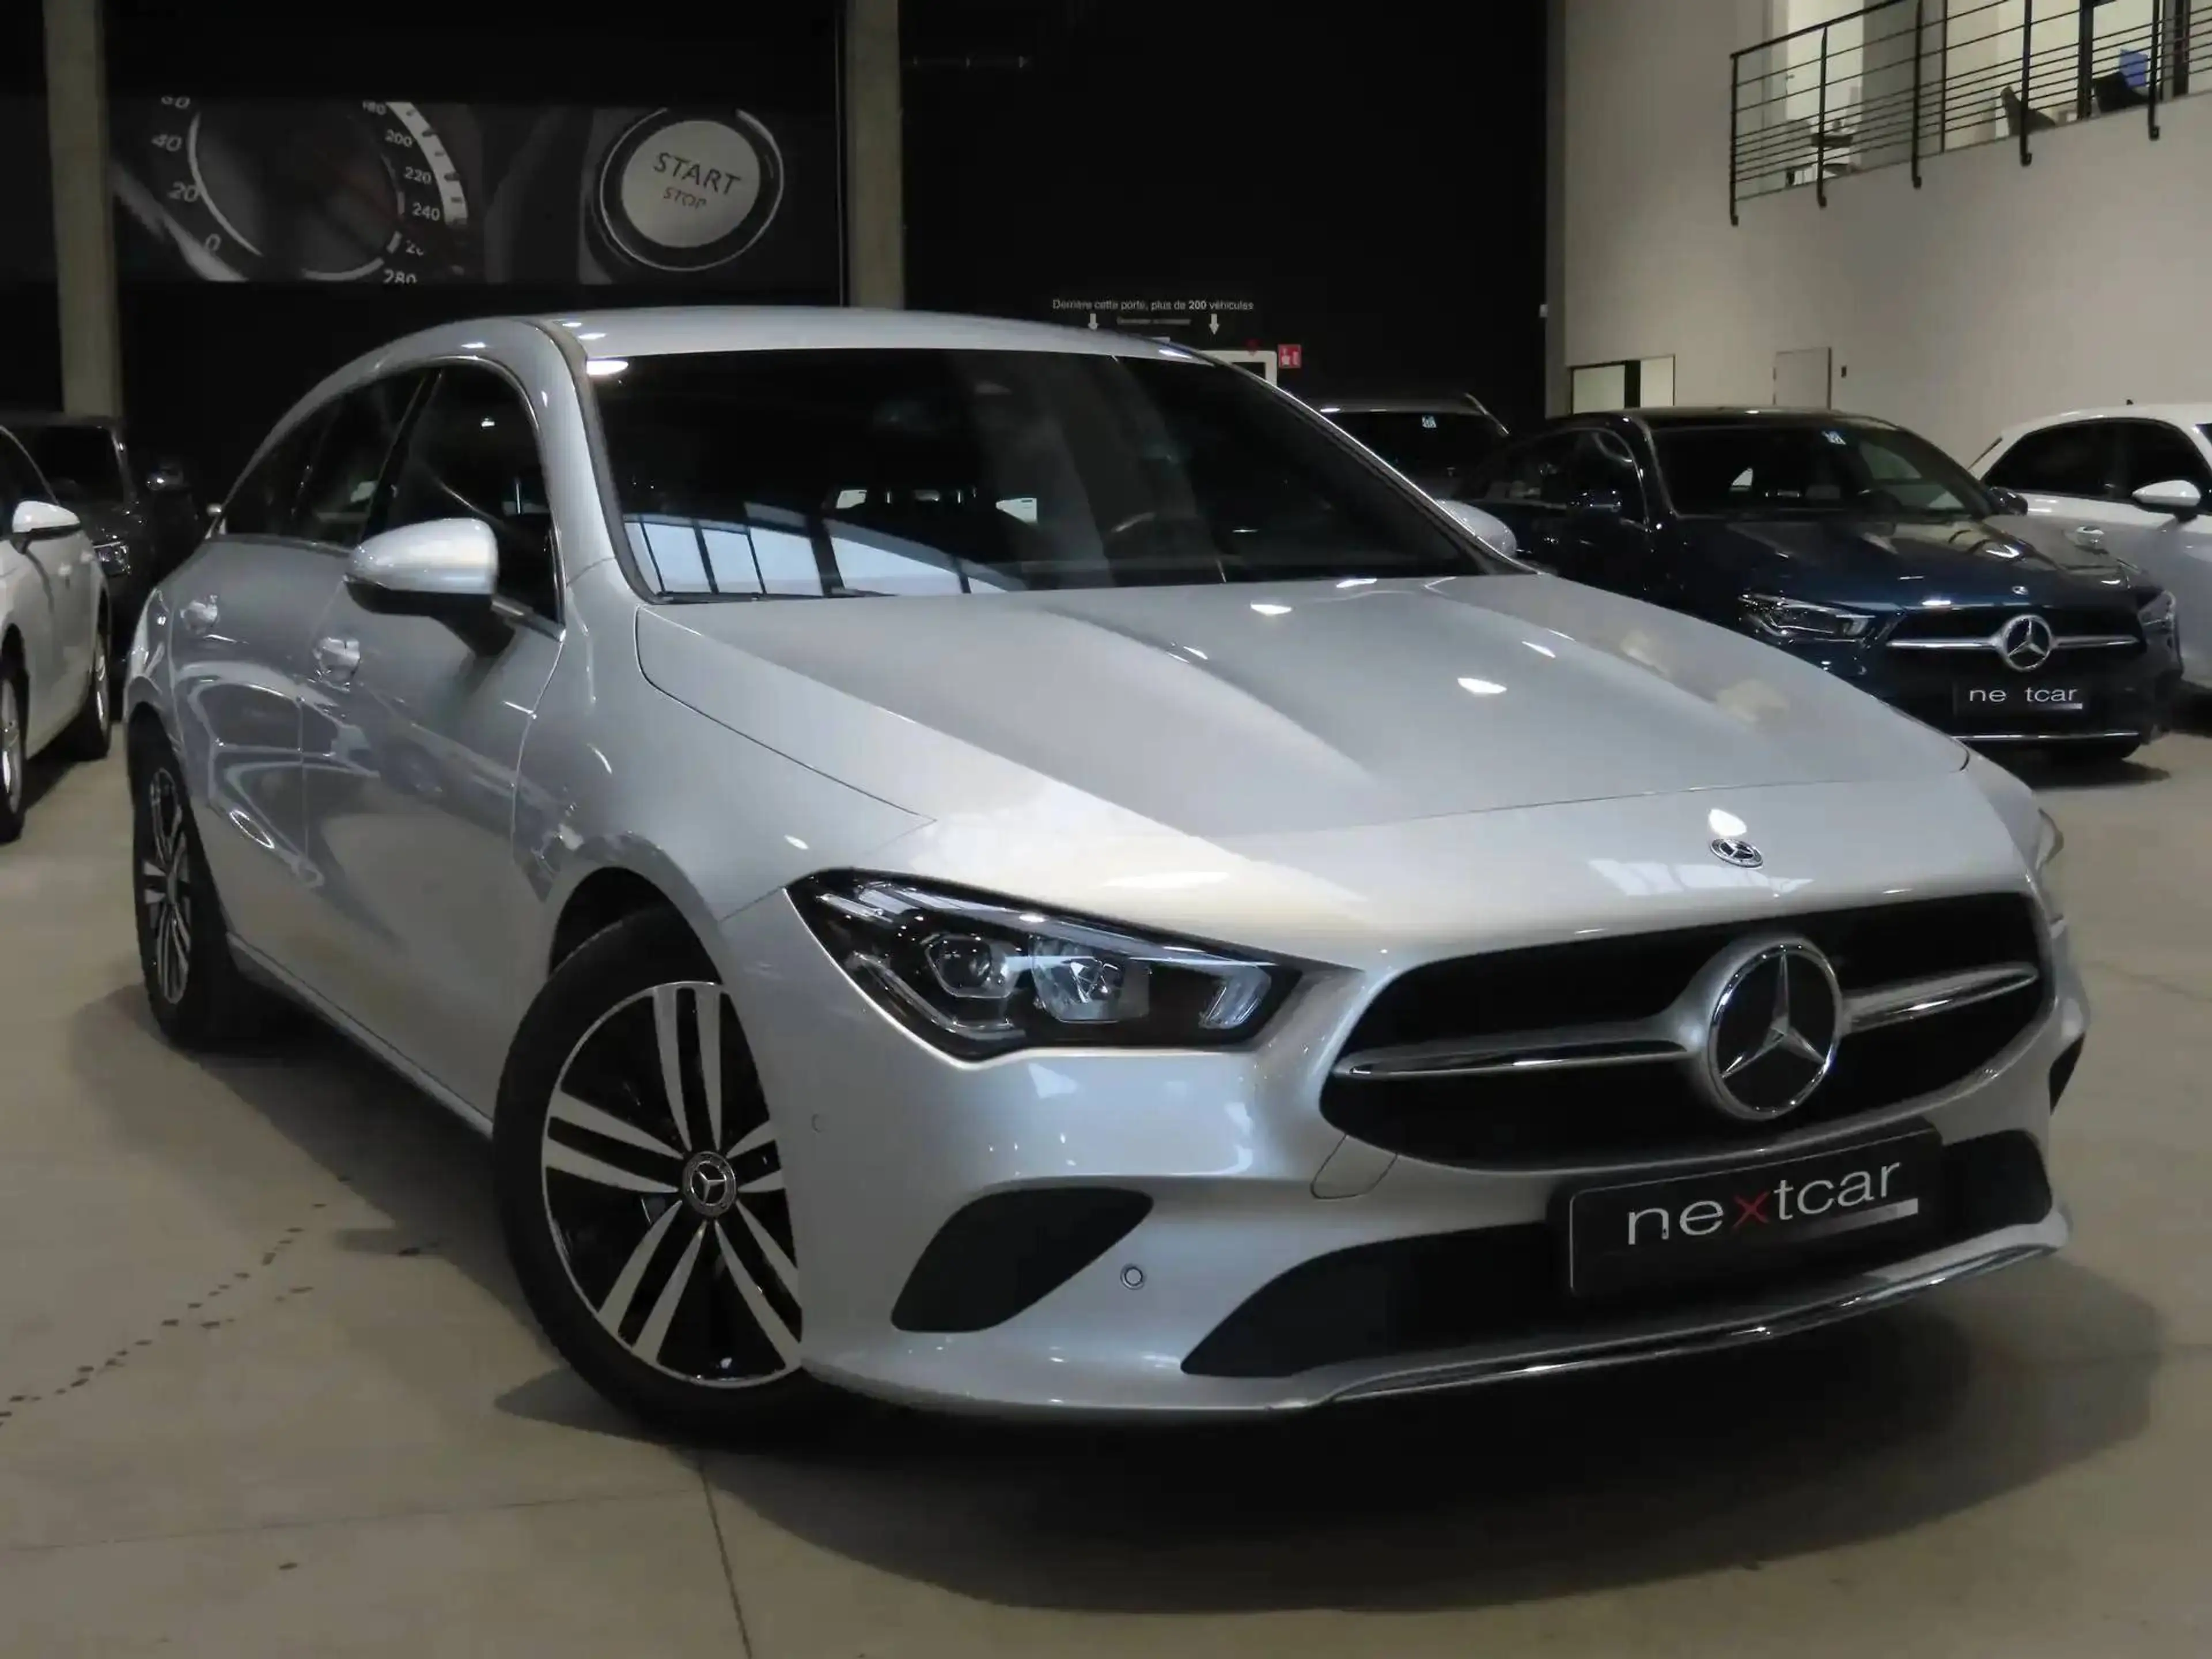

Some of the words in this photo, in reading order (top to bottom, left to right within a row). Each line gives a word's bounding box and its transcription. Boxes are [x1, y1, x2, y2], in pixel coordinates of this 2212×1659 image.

[151, 134, 183, 152] 40
[385, 128, 413, 148] 200
[404, 166, 432, 185] 220
[654, 152, 741, 195] START
[166, 180, 198, 202] 20
[663, 186, 707, 209] STOP
[412, 201, 440, 222] 240
[1150, 299, 1172, 312] plus
[1173, 299, 1187, 310] de
[1188, 299, 1208, 310] 200
[1627, 1161, 1900, 1245] nextcar
